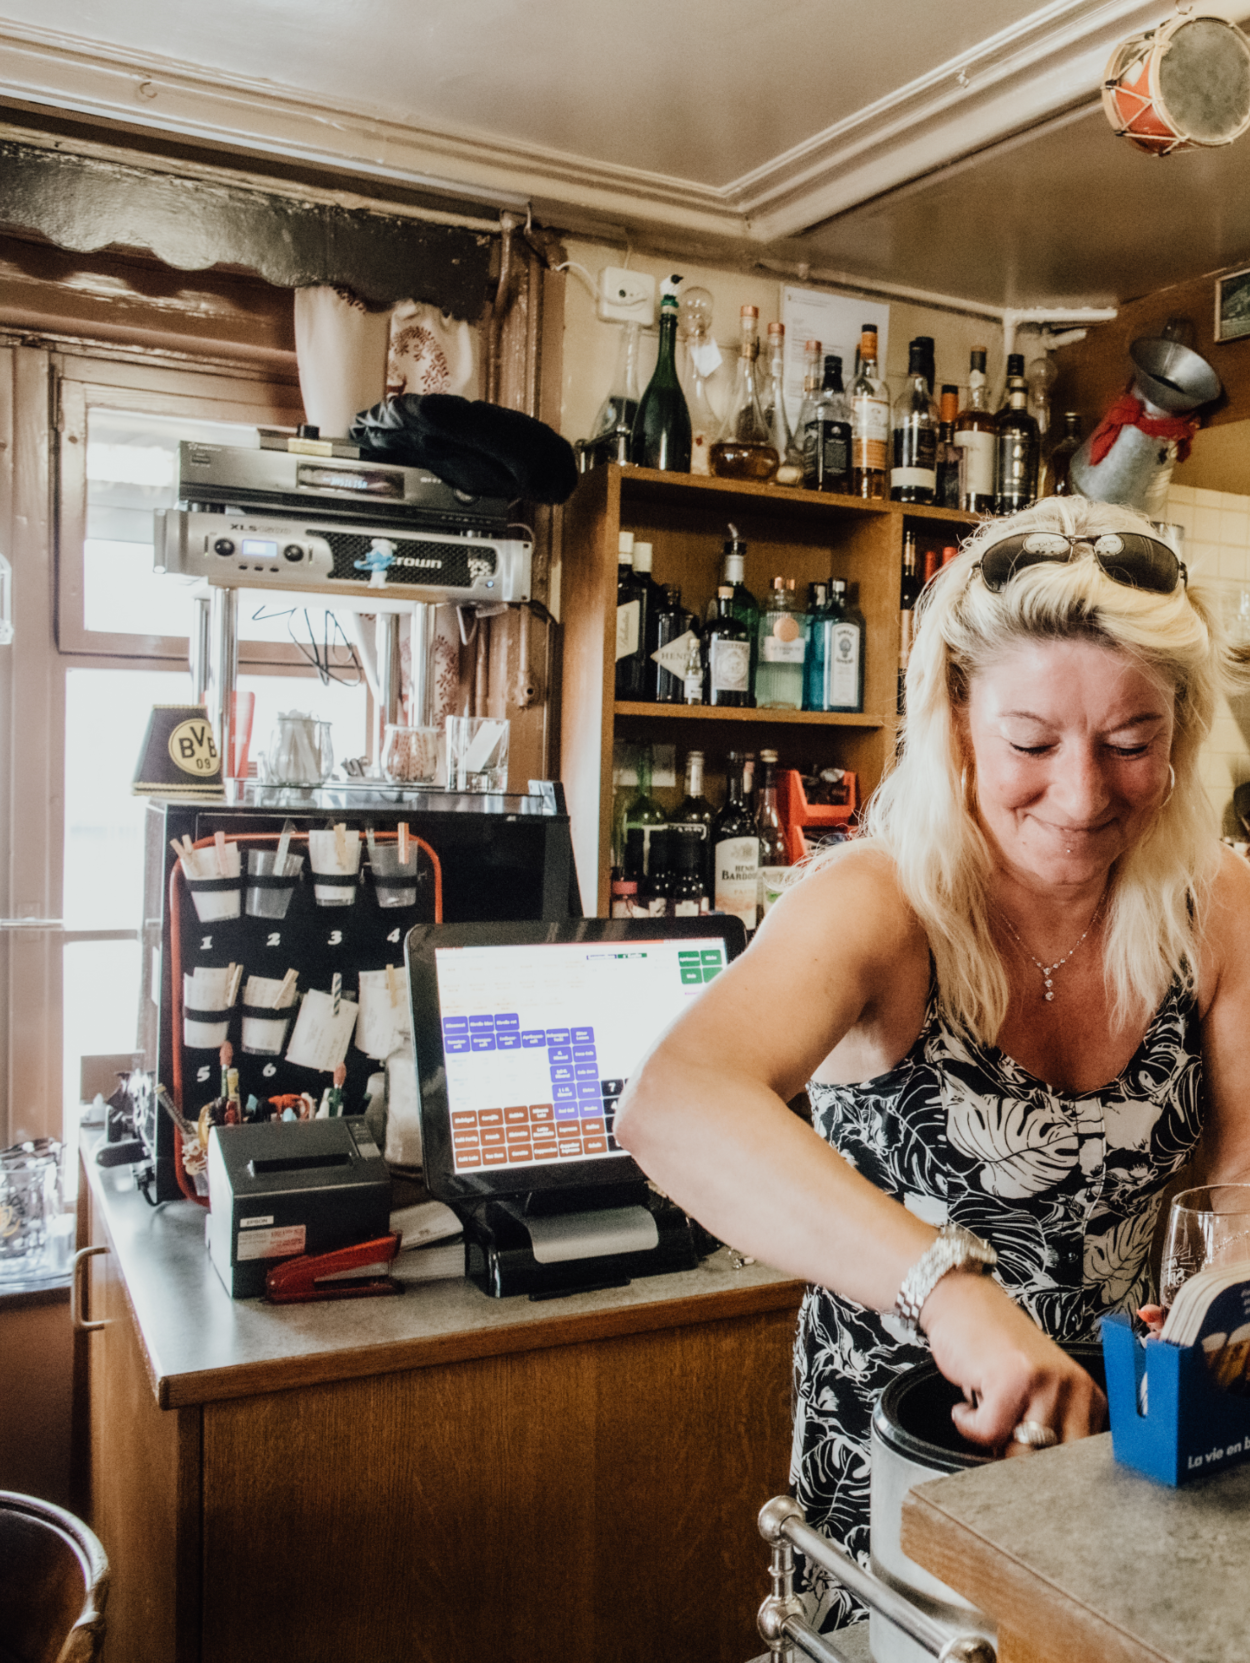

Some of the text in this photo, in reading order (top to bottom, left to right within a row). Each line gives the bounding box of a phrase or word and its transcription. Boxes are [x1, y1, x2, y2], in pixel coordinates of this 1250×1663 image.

[179, 726, 217, 758] BVB
[196, 758, 211, 770] 09
[200, 935, 213, 950] 1
[266, 932, 281, 947] 2
[327, 930, 343, 946] 3
[386, 927, 401, 943] 4
[197, 1065, 211, 1083] 5
[262, 1062, 277, 1078] 6
[608, 1082, 616, 1092] 7
[1187, 1456, 1203, 1469] La
[1205, 1447, 1224, 1463] vie
[1226, 1442, 1242, 1456] en
